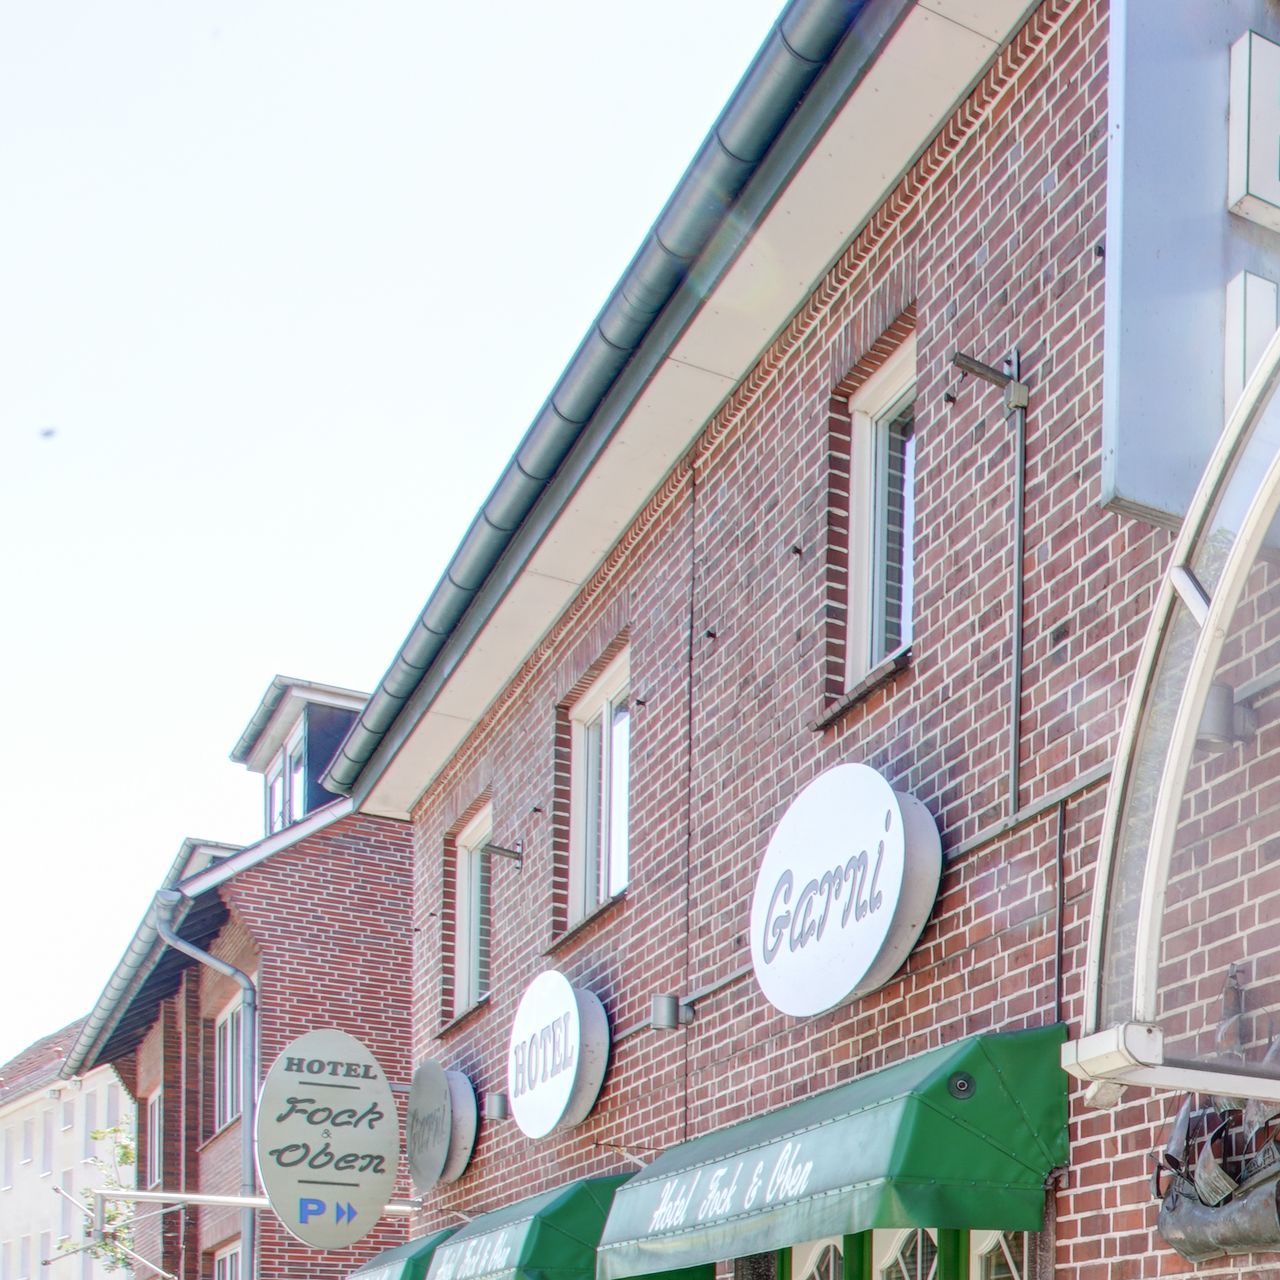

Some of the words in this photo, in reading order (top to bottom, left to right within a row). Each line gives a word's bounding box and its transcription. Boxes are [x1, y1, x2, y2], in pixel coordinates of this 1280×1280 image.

[762, 809, 893, 966] Garni
[284, 1056, 378, 1080] HOTEL
[514, 1011, 575, 1098] HOTEL
[276, 1097, 384, 1131] Fock
[321, 1128, 332, 1139] &
[269, 1143, 385, 1175] Oben
[648, 1169, 702, 1233] Hotel
[698, 1161, 744, 1221] Fock
[744, 1160, 764, 1210] &
[766, 1141, 814, 1204] Oben
[299, 1197, 327, 1225] P
